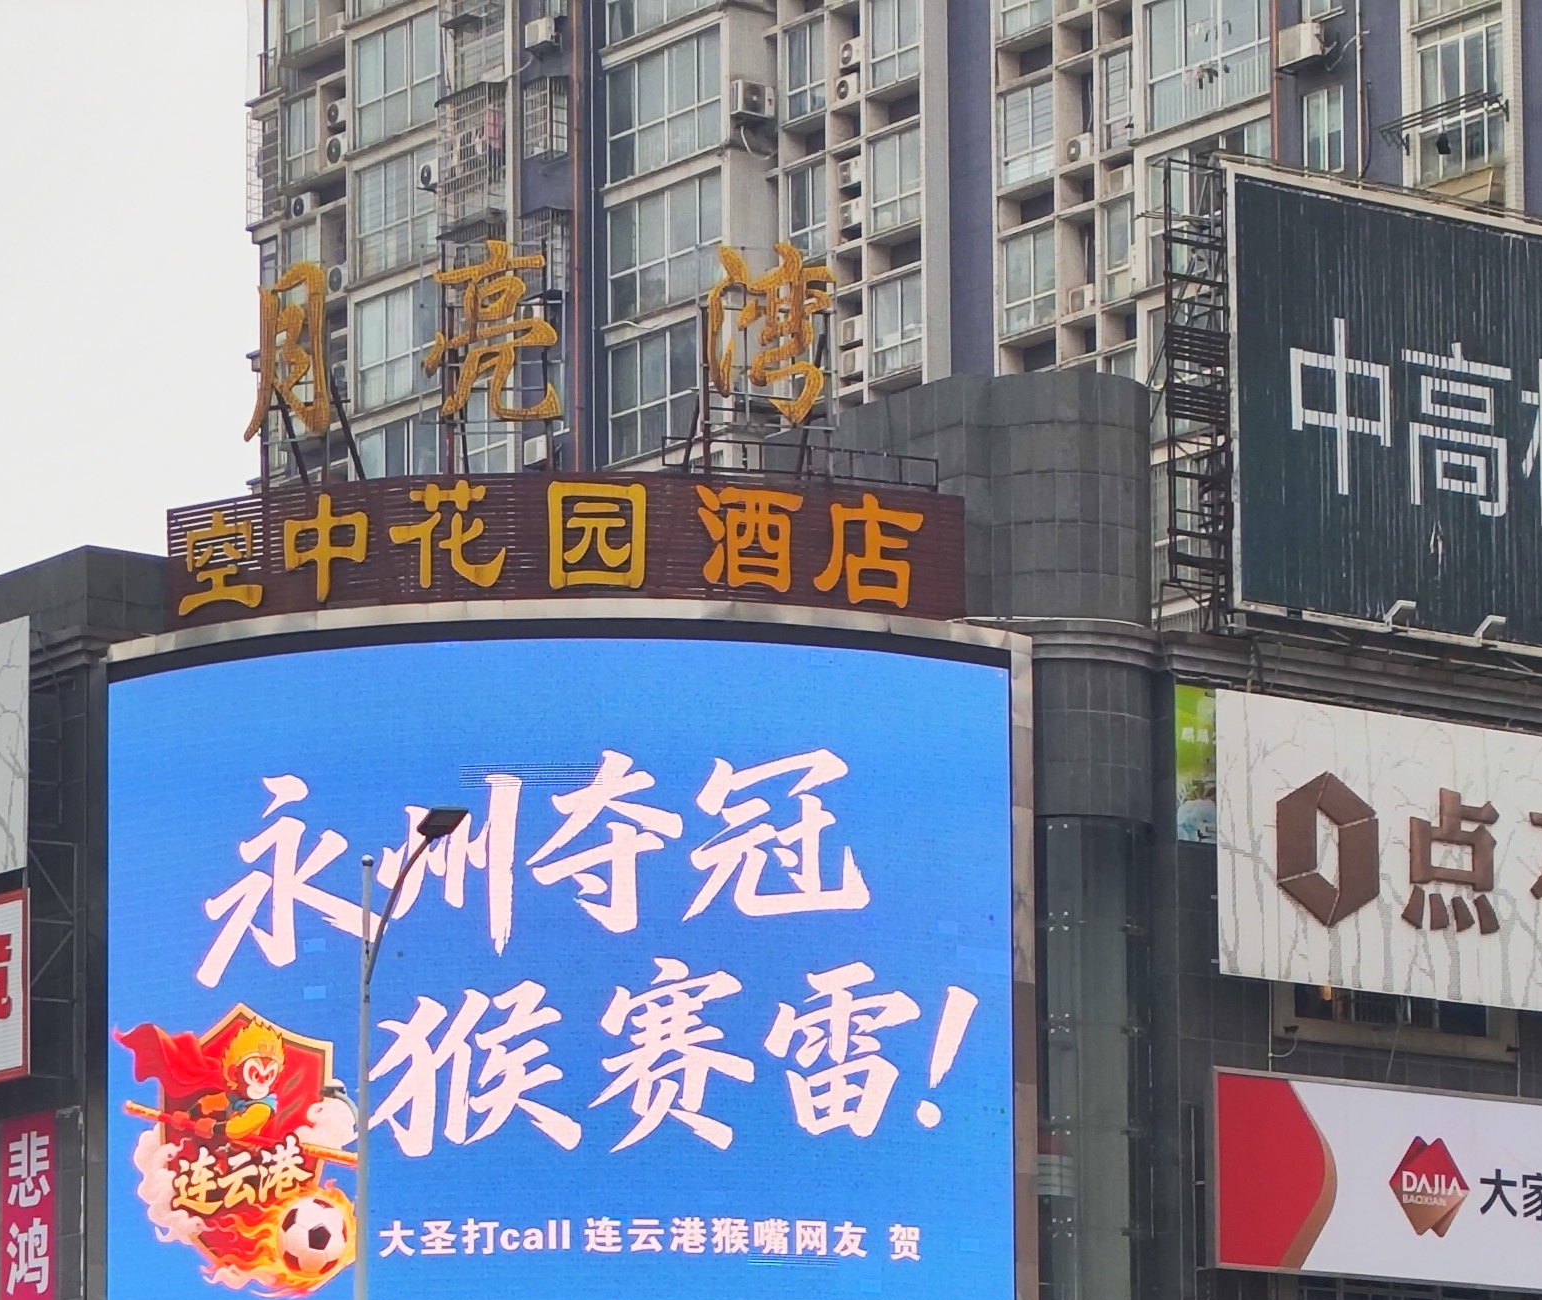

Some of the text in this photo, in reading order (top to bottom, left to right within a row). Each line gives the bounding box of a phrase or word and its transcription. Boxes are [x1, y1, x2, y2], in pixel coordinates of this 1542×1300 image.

[244, 239, 836, 443] 月亮湾
[178, 480, 924, 617] 空中花园酒店
[195, 749, 870, 988] 永州夺冠
[173, 1135, 313, 1214] 连云港
[378, 1215, 922, 1261] 大圣打call 连云港猴嘴网友 贺
